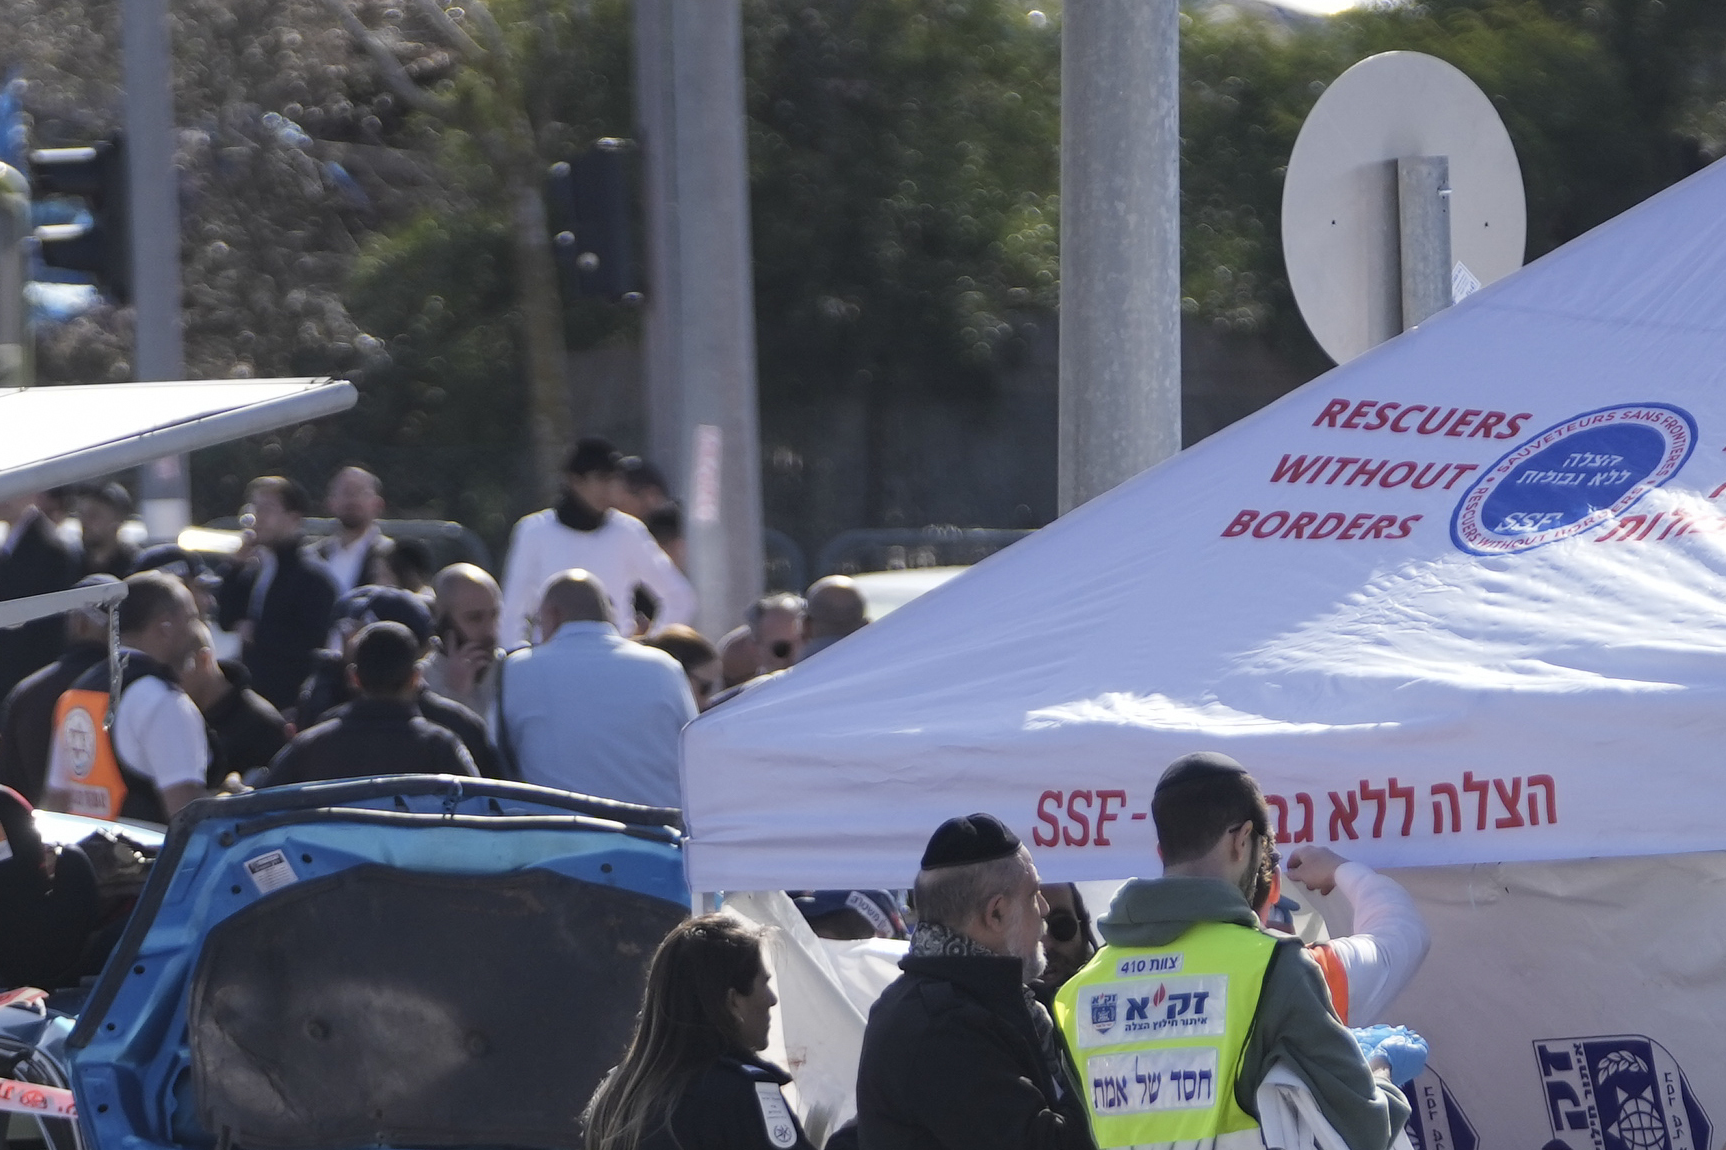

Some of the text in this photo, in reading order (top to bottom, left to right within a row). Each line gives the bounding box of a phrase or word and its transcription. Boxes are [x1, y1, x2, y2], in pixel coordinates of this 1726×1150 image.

[1312, 398, 1533, 439] RESCUERS
[1497, 411, 1616, 473] SAUVETEURS
[1620, 409, 1664, 423] SANS
[1658, 413, 1689, 477] FRONTIERES
[1562, 451, 1624, 468] הצלה
[1269, 453, 1478, 490] WITHOUT
[1515, 468, 1632, 486] ללא גבולות
[1220, 509, 1424, 540] BORDERS
[1462, 486, 1490, 543] RESCUERS
[1476, 530, 1547, 551] WITHOUT
[1494, 512, 1564, 531] SSF
[1329, 777, 1415, 841] ללא
[1431, 771, 1557, 834] הצלה
[1120, 956, 1178, 974] צוות 410
[1125, 1022, 1151, 1032] הצלה
[1181, 1017, 1208, 1027] איתור
[1093, 1055, 1213, 1109] חסד של אמת
[1423, 1085, 1440, 1120] חסד
[1663, 1071, 1676, 1107] חסד
[1672, 1114, 1685, 1140] של
